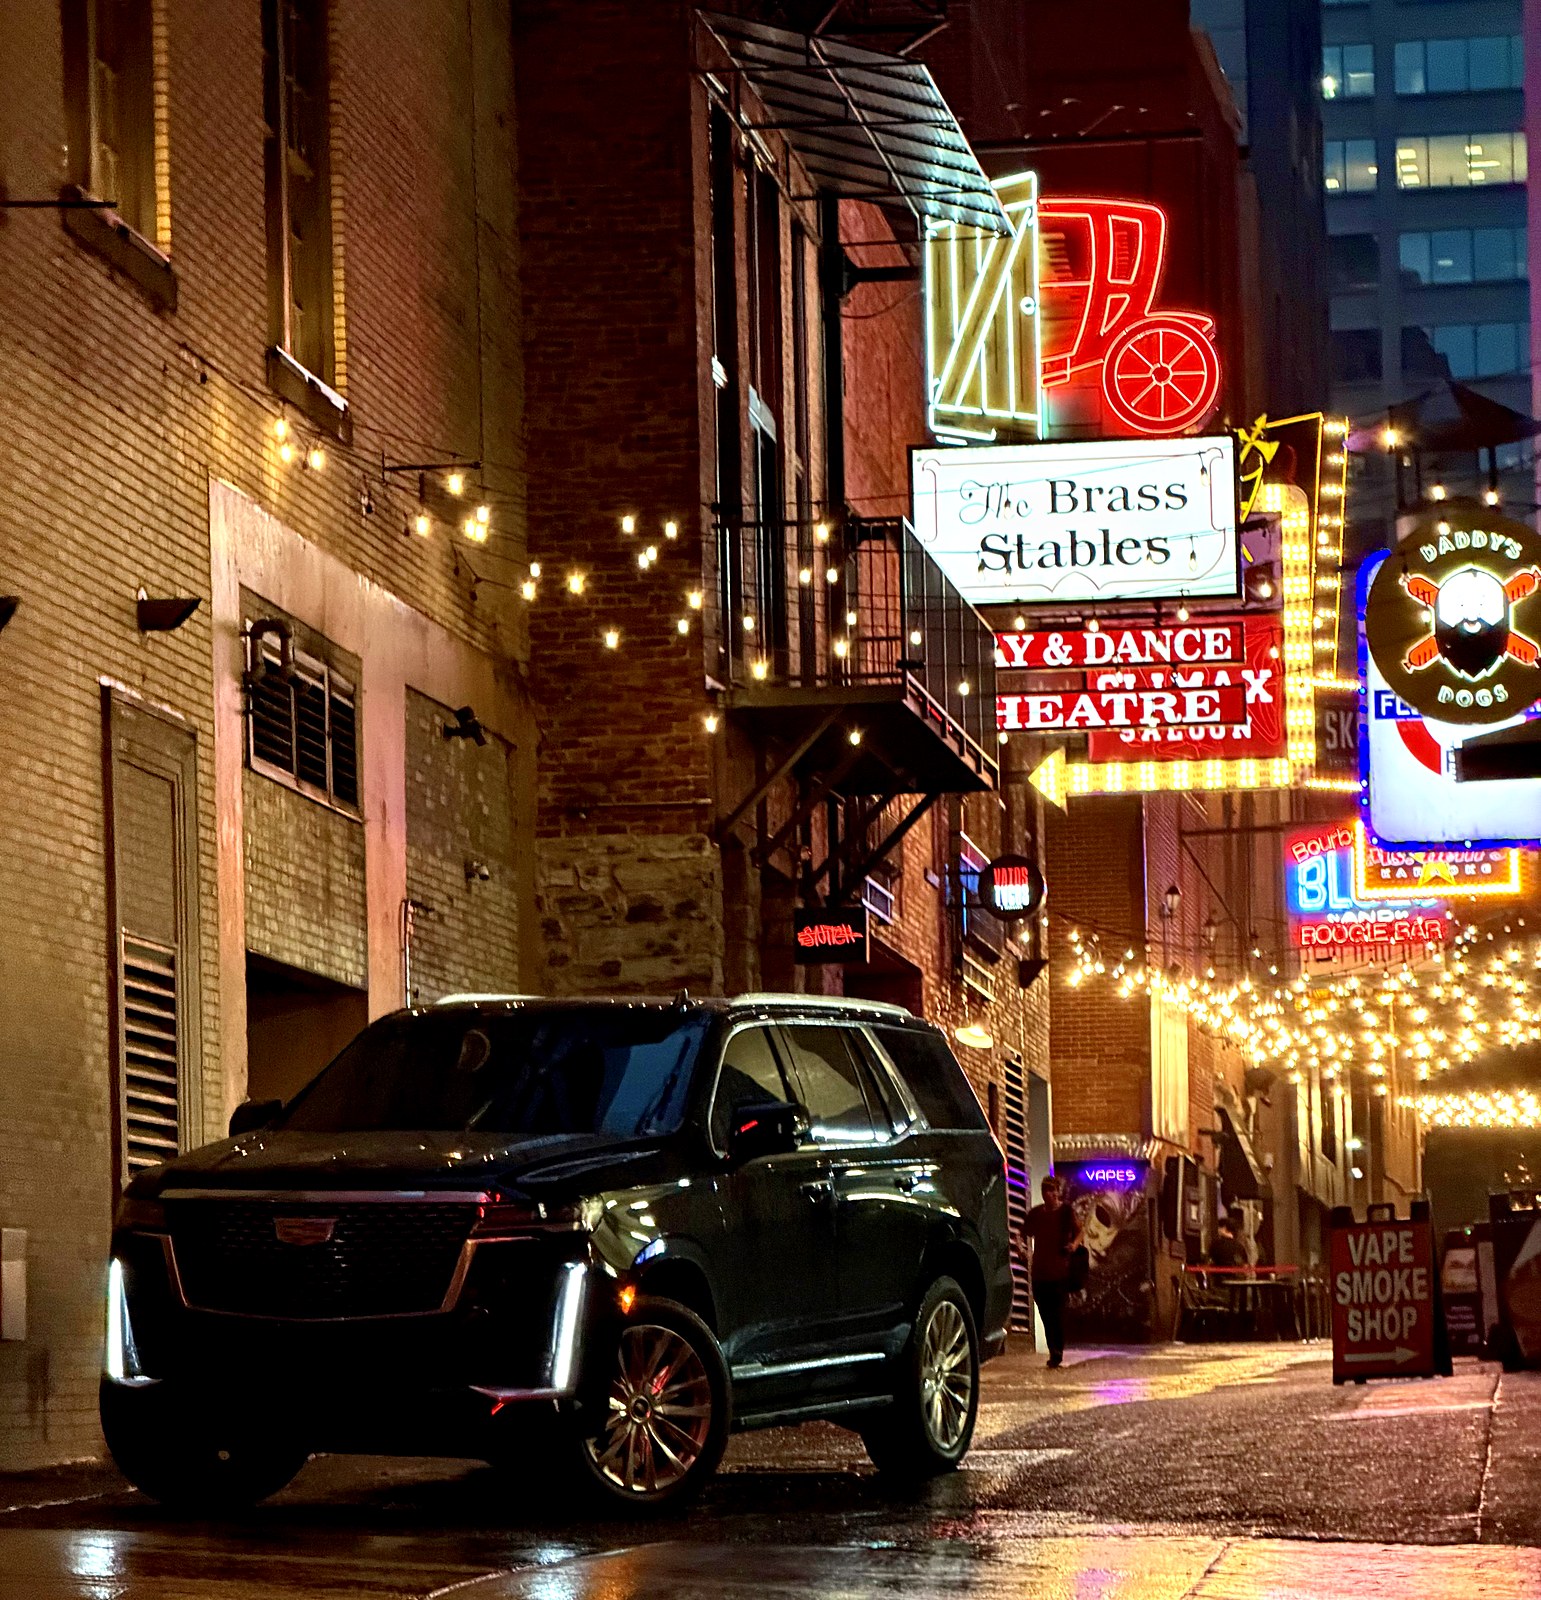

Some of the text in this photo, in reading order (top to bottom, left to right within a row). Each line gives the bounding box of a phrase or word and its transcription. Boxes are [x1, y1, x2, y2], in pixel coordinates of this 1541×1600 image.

[959, 478, 1188, 524] The Brass
[980, 529, 1172, 570] Stables
[1420, 530, 1523, 562] DADDY'S
[1043, 632, 1073, 666] &
[1083, 628, 1232, 664] DANCE
[1437, 684, 1509, 707] DOGS
[1292, 829, 1354, 863] Bourb
[994, 867, 1028, 886] VATOS
[1301, 920, 1443, 945] BOOGIE BAR
[1341, 910, 1395, 923] AND
[1085, 1169, 1136, 1182] VAPES
[1347, 1231, 1414, 1266] VAPE
[1336, 1267, 1429, 1304] SMOKE
[1348, 1305, 1417, 1343] SHOP
